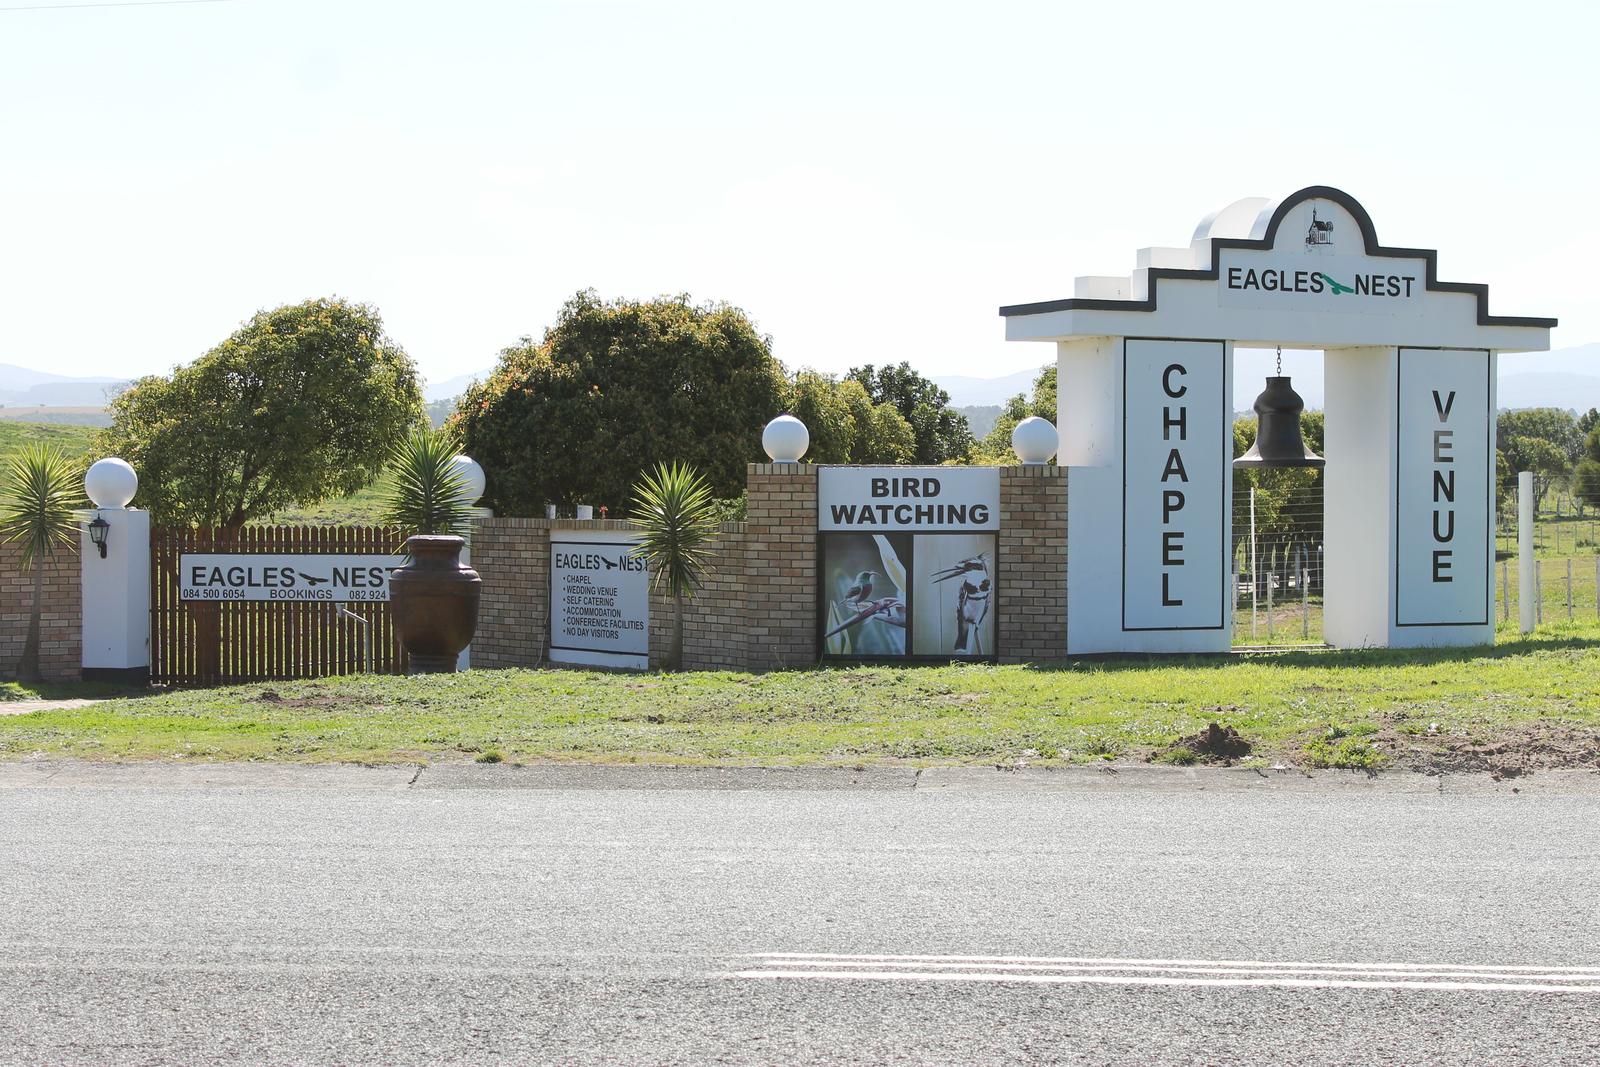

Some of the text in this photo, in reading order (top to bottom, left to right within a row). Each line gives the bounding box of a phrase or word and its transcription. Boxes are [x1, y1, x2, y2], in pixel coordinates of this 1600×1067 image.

[1228, 267, 1415, 298] EAGLES NEST
[871, 477, 941, 498] BIRD
[1160, 363, 1189, 606] CHAPEL
[1432, 390, 1456, 583] VENUE
[830, 504, 990, 525] WATCHING
[556, 554, 648, 571] EAGLES NEST
[191, 566, 296, 588] EAGLES
[566, 575, 591, 584] CHAPEL
[183, 588, 245, 599] 084 500 6054
[269, 589, 333, 600] BOOKINGS
[349, 590, 386, 600] 082 924
[566, 585, 618, 597] WEDDING VENUE
[566, 595, 614, 606] SELF CATERING
[566, 607, 621, 618] ACCOMMODATION
[566, 617, 644, 630] CONFERENCE FACILITIES
[566, 627, 619, 639] NO DAY VISITORS
